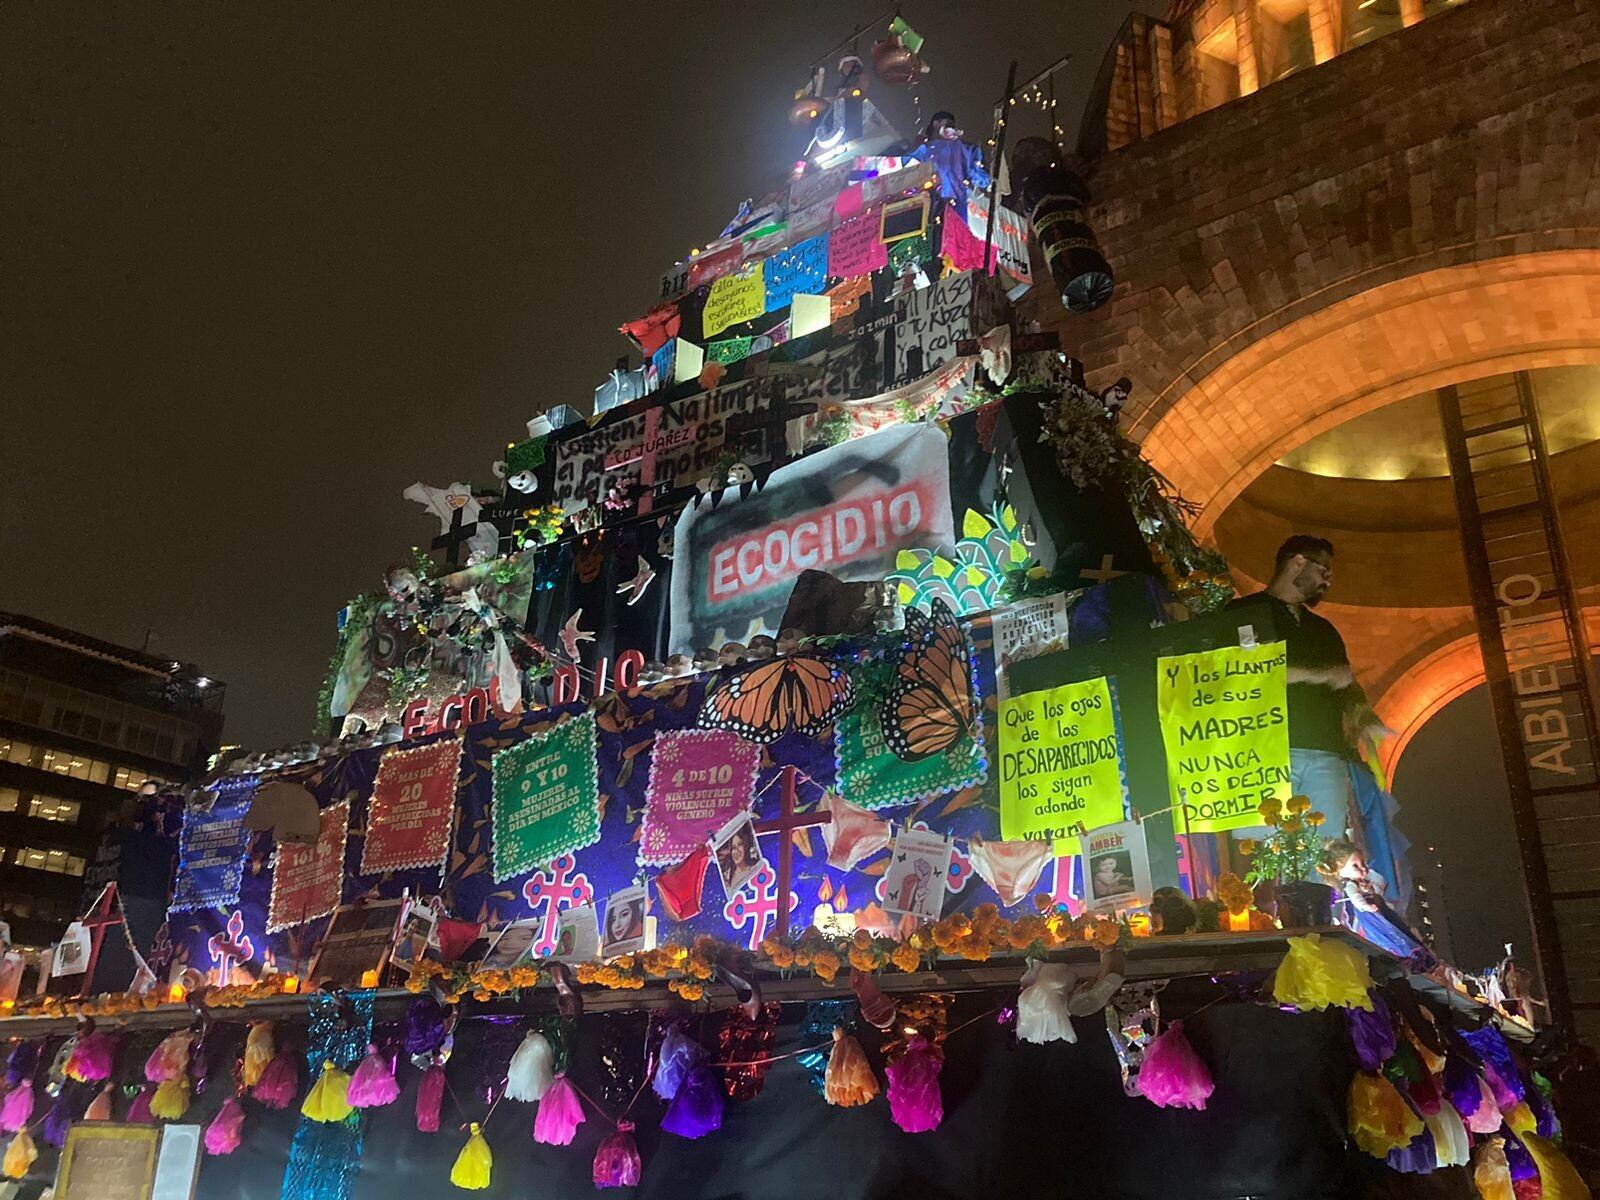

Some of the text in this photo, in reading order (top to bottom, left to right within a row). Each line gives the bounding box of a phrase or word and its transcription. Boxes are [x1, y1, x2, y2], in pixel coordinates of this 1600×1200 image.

[713, 490, 923, 596] ECOCIDIO
[1167, 665, 1180, 688] Y
[1499, 573, 1577, 776] ABIERTO
[1191, 689, 1216, 707] de
[1005, 694, 1102, 728] Que los ojos
[1021, 720, 1079, 744] de los
[1179, 705, 1285, 747] MADRES
[524, 751, 561, 775] ENTRE
[1002, 734, 1117, 783] DESAPARECIDOS
[1179, 748, 1262, 775] NUNCA
[521, 763, 568, 794] 9 Y 10
[671, 764, 733, 788] 4 DE 10
[1017, 774, 1093, 801] los sigan
[1227, 765, 1291, 791] DEJEN
[399, 782, 423, 803] 20
[507, 785, 581, 824] ASESINADAS AL
[521, 782, 566, 809] MUJERES
[665, 798, 732, 812] VIOLENCIA DE
[695, 787, 734, 801] SUFREN
[1034, 794, 1086, 817] adonde
[527, 813, 541, 826] EN
[1090, 835, 1125, 851] AMBER
